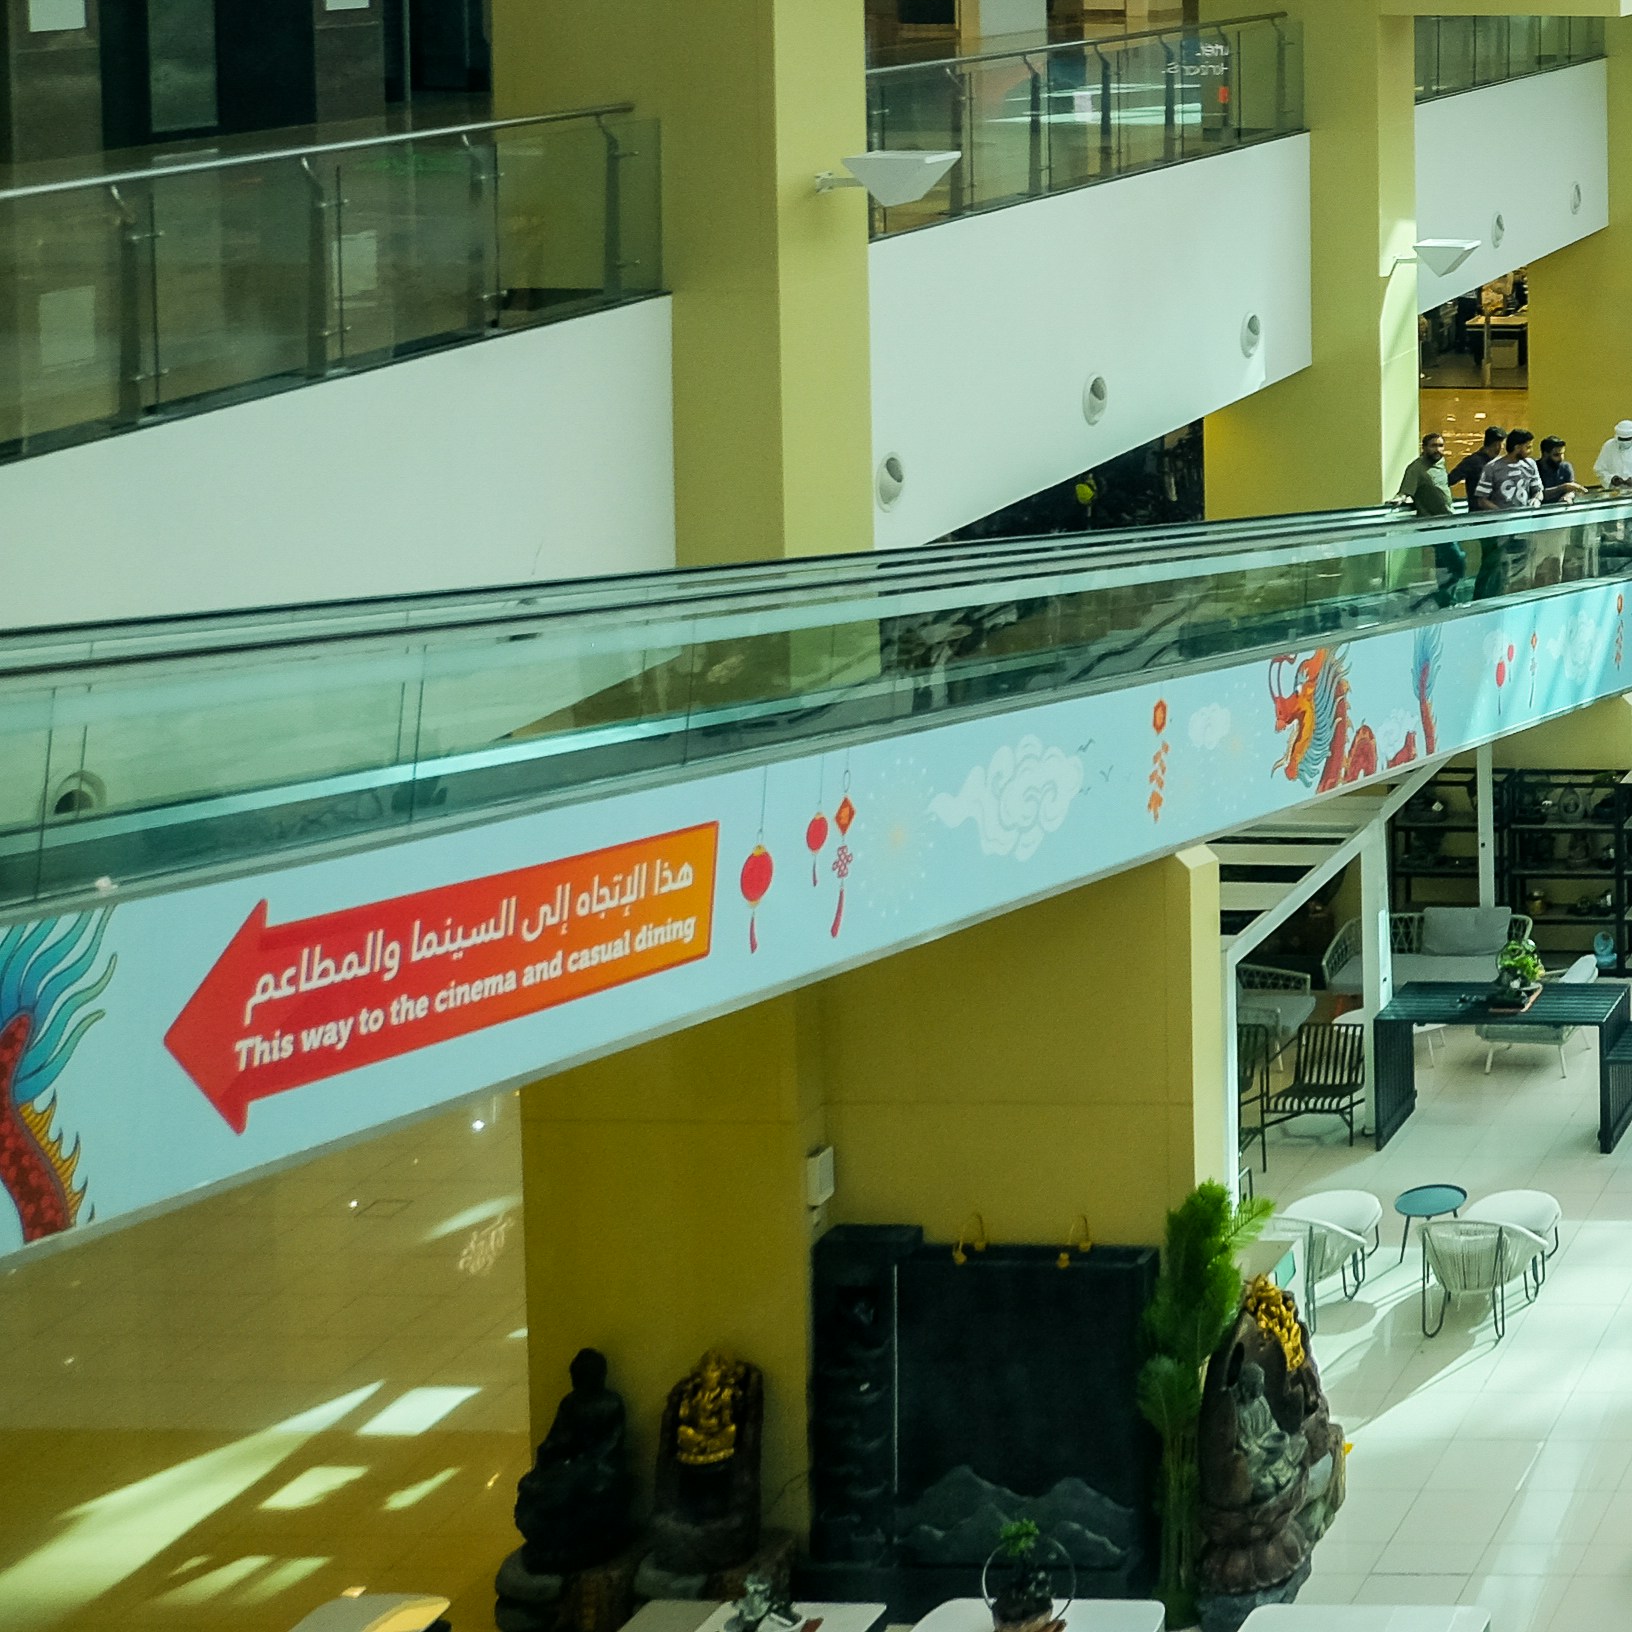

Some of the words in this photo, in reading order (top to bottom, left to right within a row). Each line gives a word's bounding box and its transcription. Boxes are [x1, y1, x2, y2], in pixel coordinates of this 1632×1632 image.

[575, 862, 647, 920] الإتجاه
[653, 858, 694, 896] هذا
[410, 895, 517, 962] السينما
[522, 881, 571, 942] إلى
[234, 1029, 294, 1072] This
[301, 1016, 354, 1053] way
[358, 1007, 384, 1035] to
[390, 994, 429, 1026] the
[434, 970, 517, 1013] cinema
[522, 951, 562, 987] and
[567, 930, 630, 972] casual
[635, 916, 697, 952] dining
[243, 929, 401, 1027] والمطاعم
